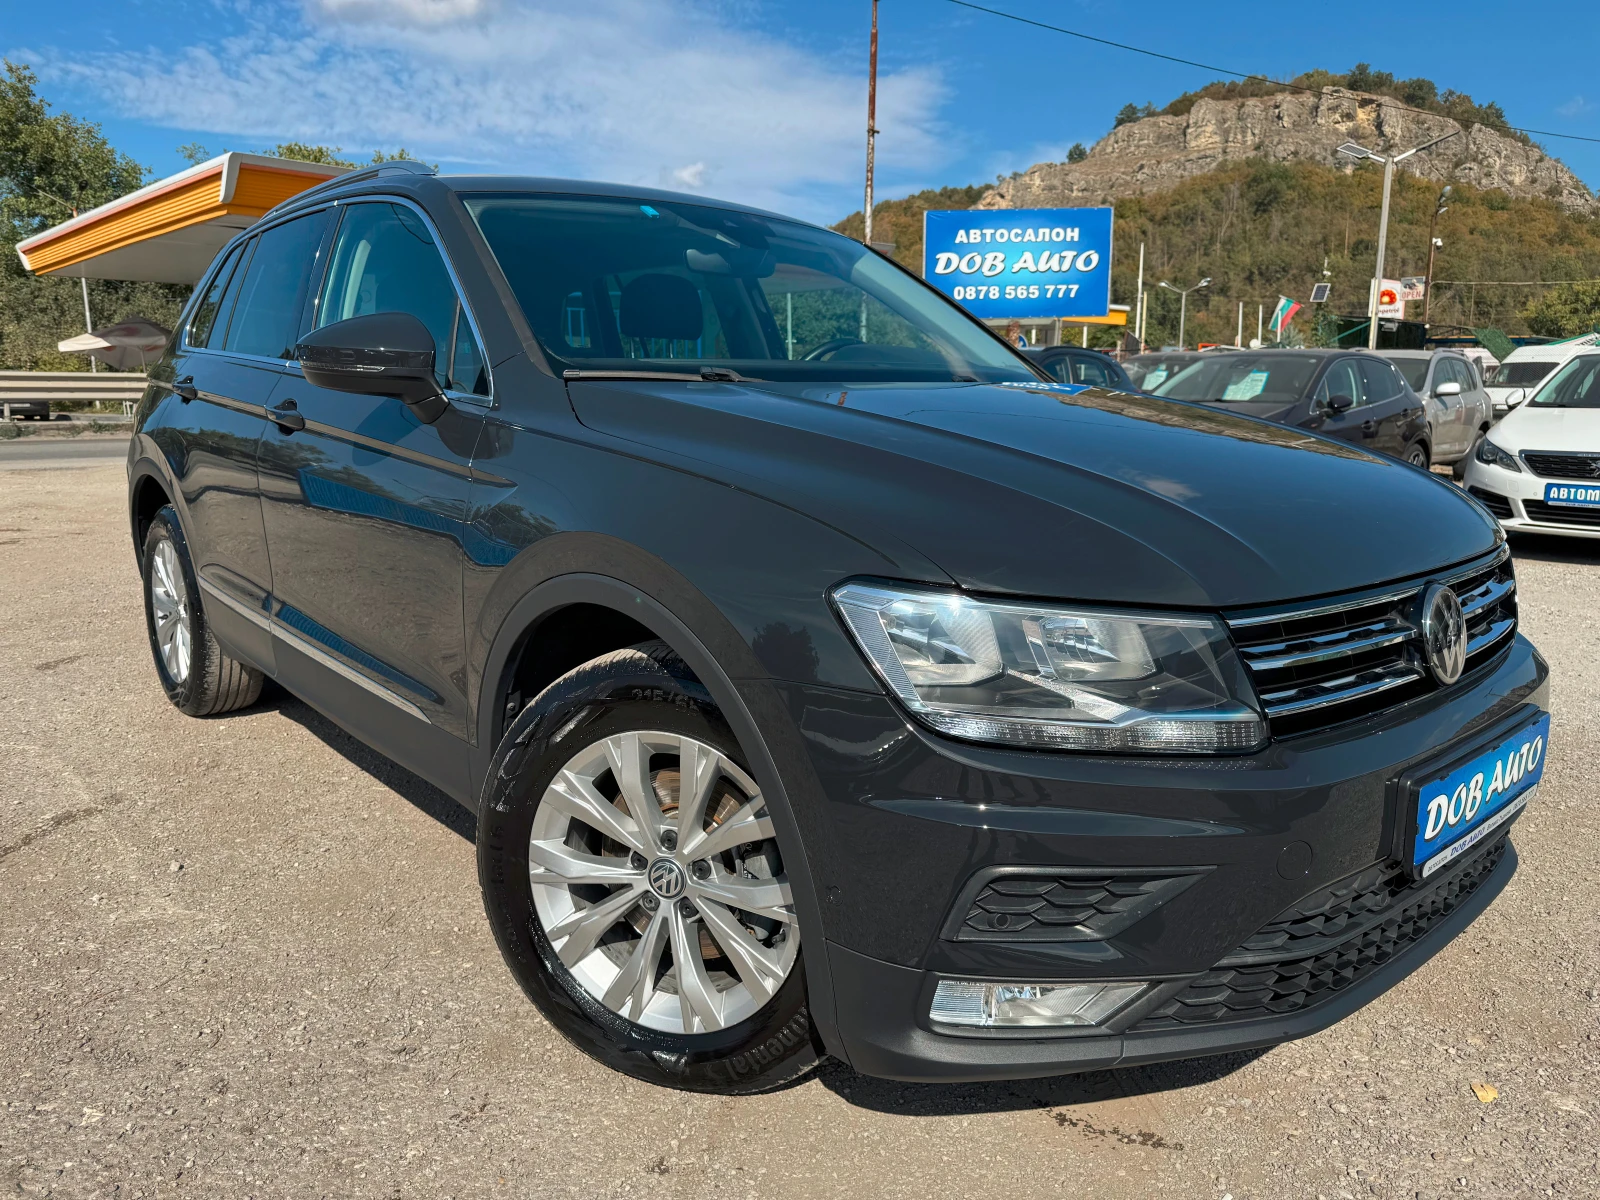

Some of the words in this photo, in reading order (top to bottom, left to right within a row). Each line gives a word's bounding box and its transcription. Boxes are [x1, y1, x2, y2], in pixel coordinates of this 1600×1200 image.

[954, 227, 1080, 244] АВТОСАЛОН
[934, 251, 1006, 277] DOB
[1011, 249, 1100, 273] AUTO
[953, 286, 1000, 300] 0878
[1005, 285, 1040, 299] 565
[1045, 284, 1080, 298] 777
[1401, 290, 1421, 299] OPEN
[1549, 486, 1600, 501] АВТОМ
[1424, 772, 1484, 842] DOB
[1486, 734, 1543, 804] AUTO
